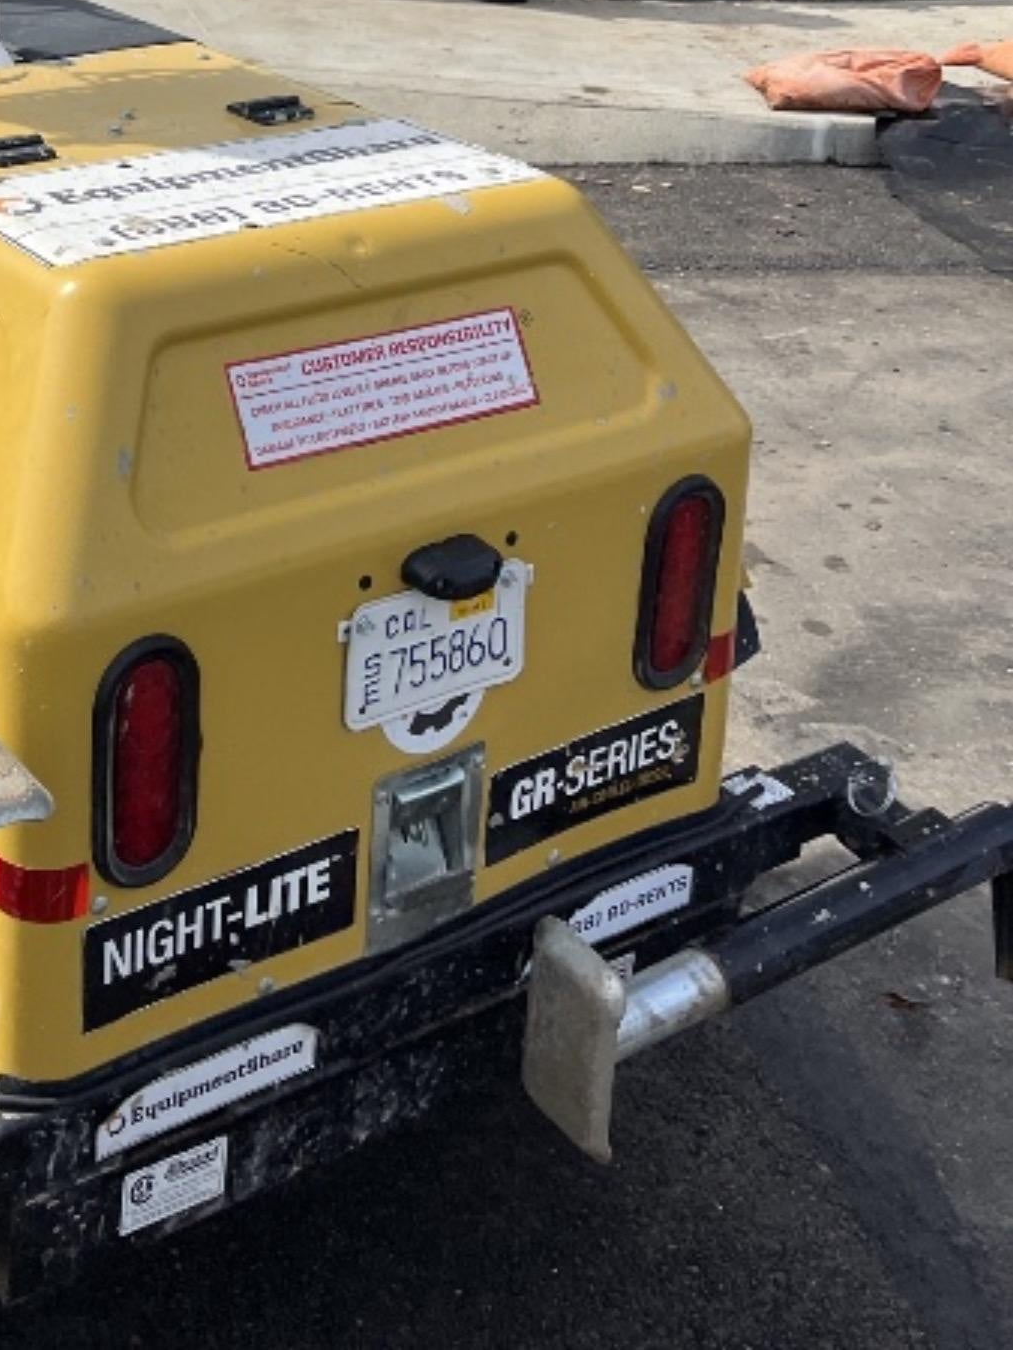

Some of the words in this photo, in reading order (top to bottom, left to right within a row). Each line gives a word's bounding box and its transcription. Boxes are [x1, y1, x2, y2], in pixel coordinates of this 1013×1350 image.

[47, 134, 441, 205] EquipmentShare
[301, 344, 388, 376] CUSTOMER
[389, 317, 511, 356] RESPONSIBILITY
[384, 607, 432, 640] CAL
[389, 616, 507, 695] 755860
[509, 718, 680, 820] GR-SERIES
[102, 858, 331, 985] NIGHT-LITE
[130, 1039, 304, 1126] EquipmentShare
